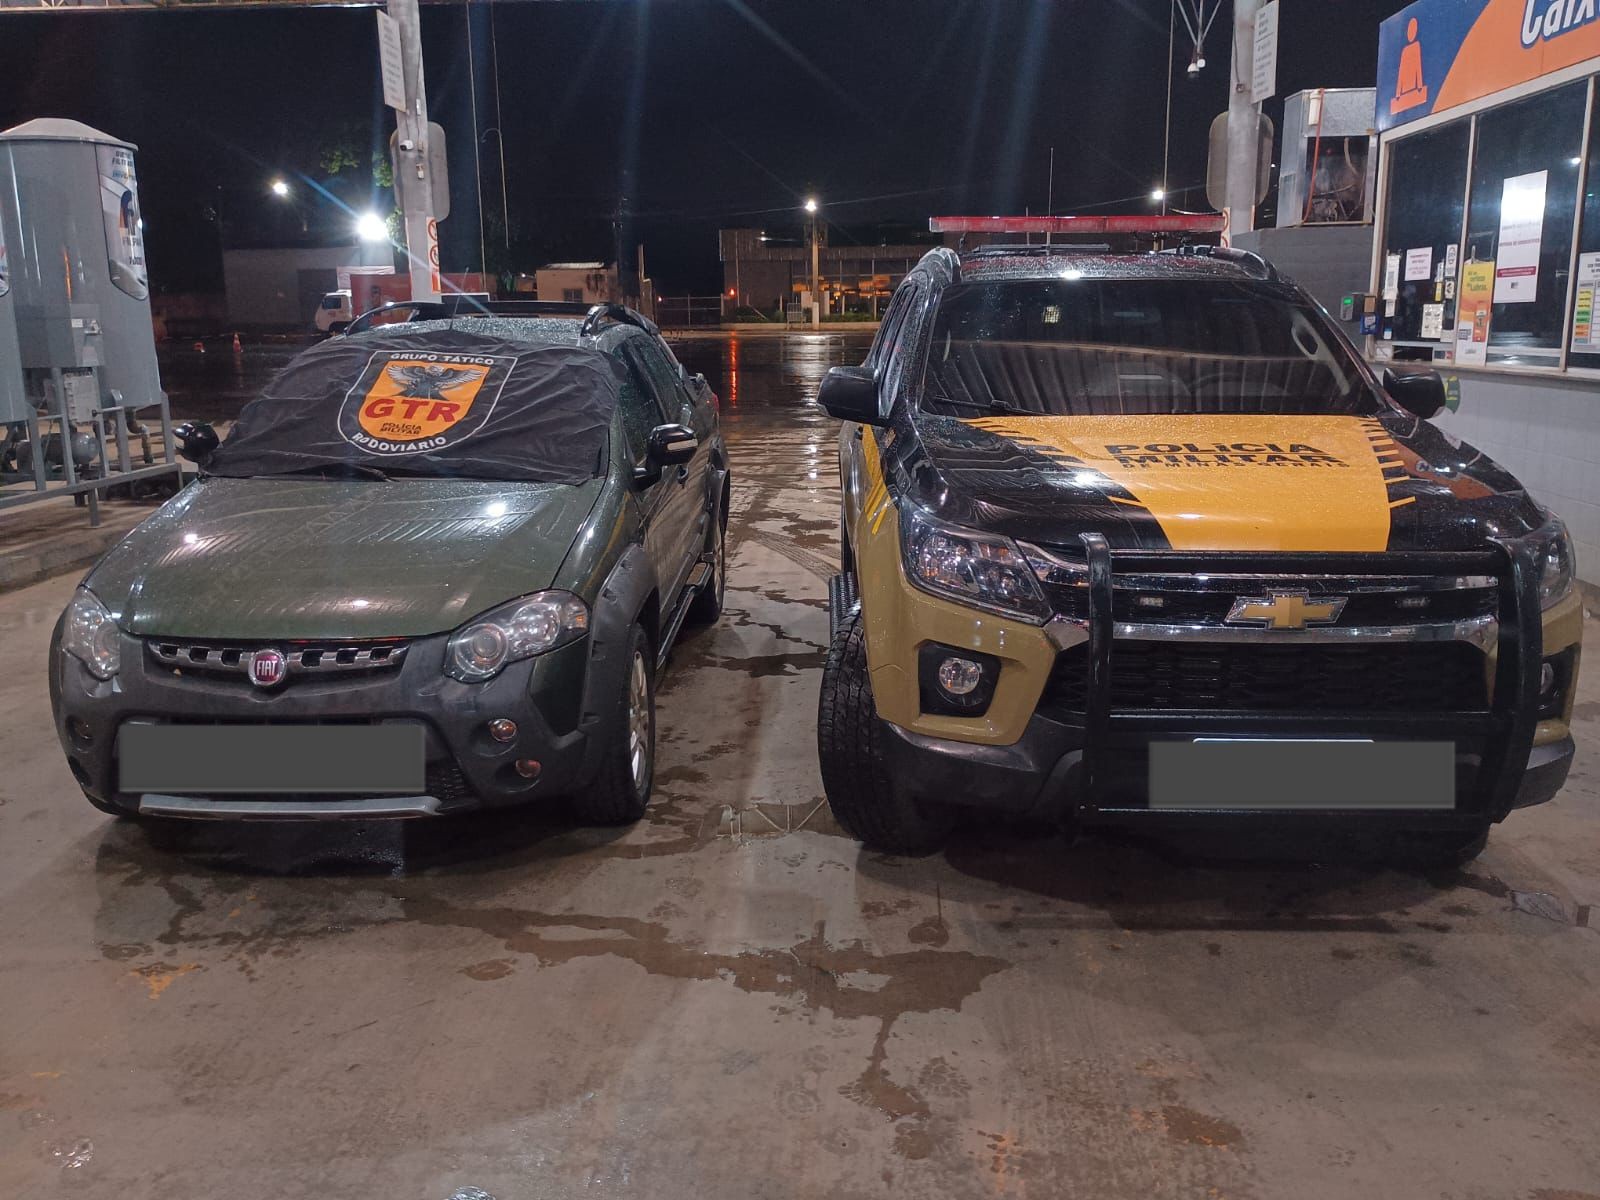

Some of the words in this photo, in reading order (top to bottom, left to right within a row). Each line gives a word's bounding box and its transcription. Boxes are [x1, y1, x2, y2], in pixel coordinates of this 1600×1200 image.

[1521, 0, 1600, 44] Caix
[390, 353, 437, 361] GRUPO
[445, 355, 495, 365] TÁTICO
[365, 399, 461, 422] GTR
[379, 427, 421, 435] MILITAR
[382, 422, 422, 431] POLÍCIA
[351, 432, 447, 452] RODOVIÁRIO
[1112, 454, 1348, 464] MILITAR
[256, 660, 278, 677] FIAT
